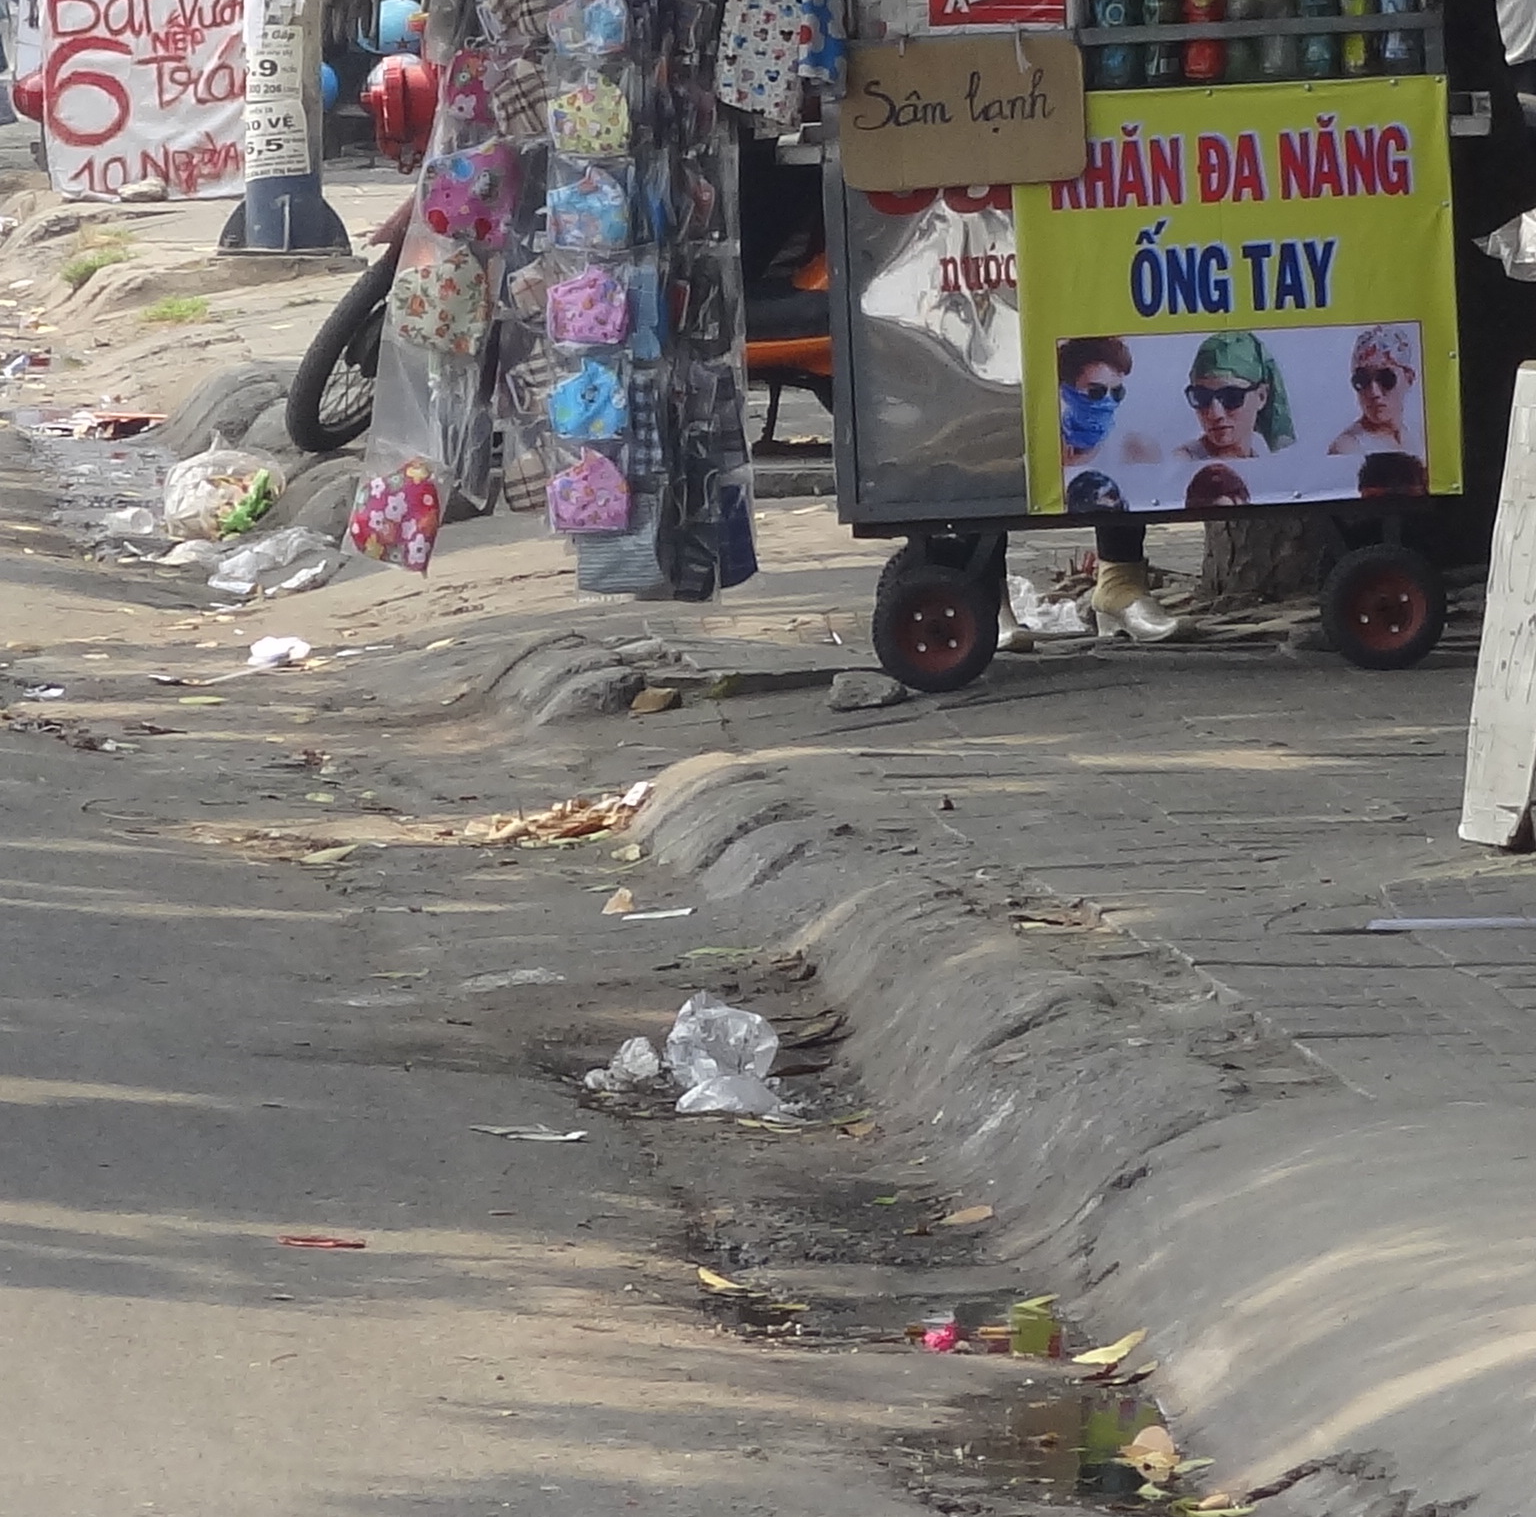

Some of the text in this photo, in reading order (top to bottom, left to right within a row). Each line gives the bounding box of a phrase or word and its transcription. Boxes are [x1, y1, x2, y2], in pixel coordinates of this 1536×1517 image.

[44, 36, 133, 146] 6
[853, 67, 1056, 134] Sâm lạnh
[1196, 131, 1265, 204] ĐA
[1278, 114, 1411, 198] NĂNG
[1130, 219, 1339, 317] ỐNG TAY
